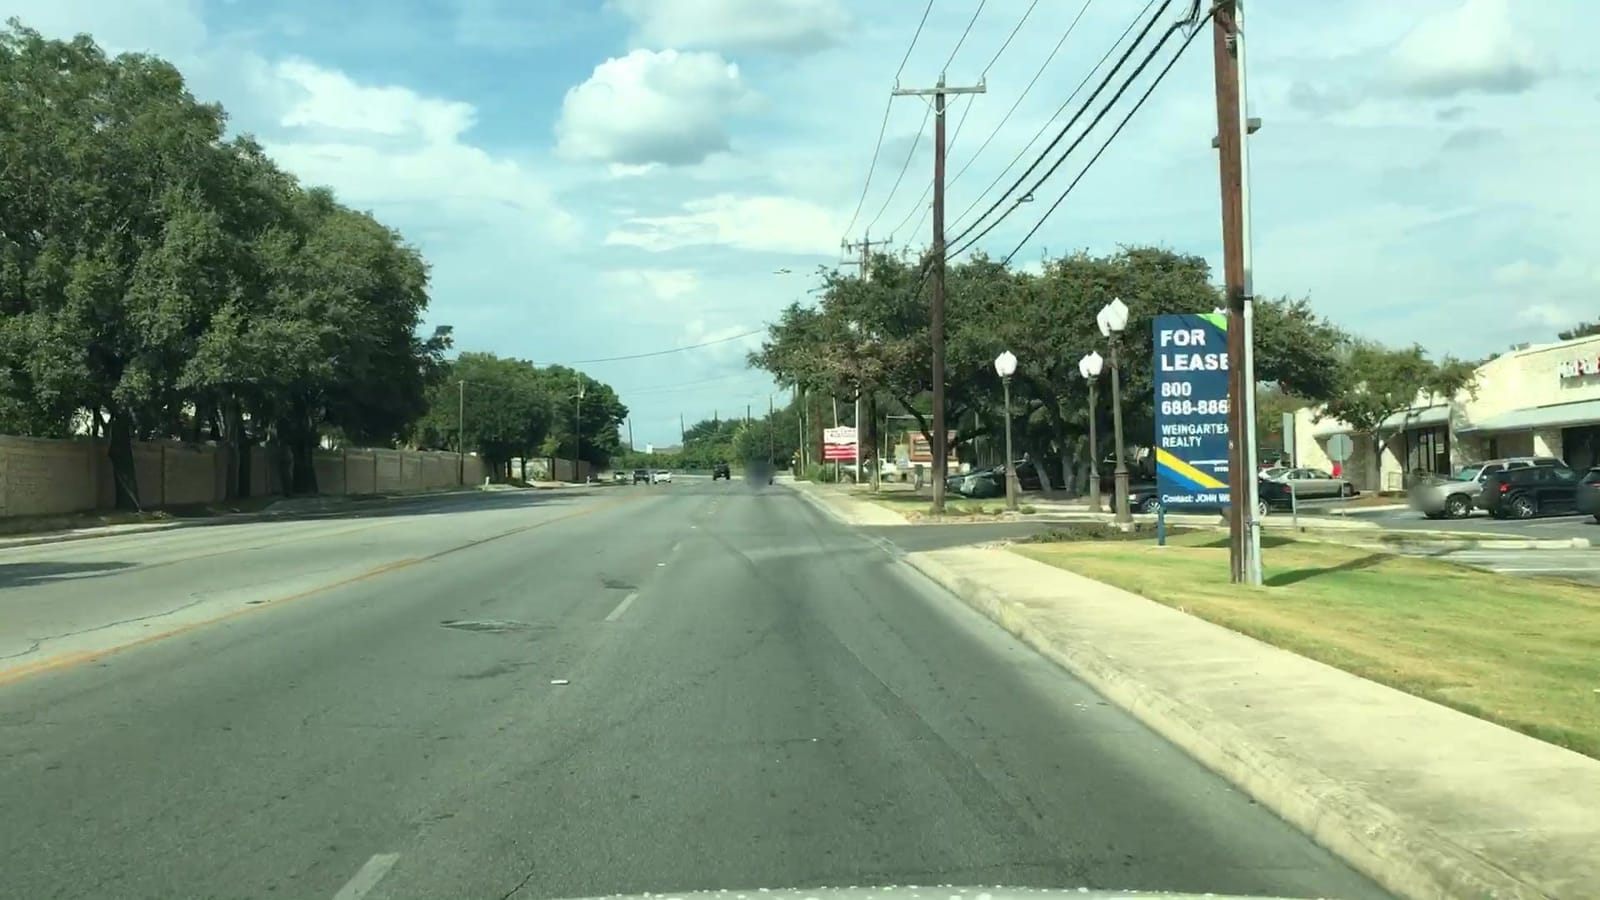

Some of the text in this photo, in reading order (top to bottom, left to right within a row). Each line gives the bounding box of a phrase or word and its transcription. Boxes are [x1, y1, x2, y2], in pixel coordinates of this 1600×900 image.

[1160, 329, 1206, 347] FOR
[1161, 353, 1229, 371] LEASE
[1161, 382, 1192, 397] 800
[1161, 399, 1230, 415] 688-886
[1162, 436, 1202, 448] REALTY
[1195, 493, 1217, 503] JOHN
